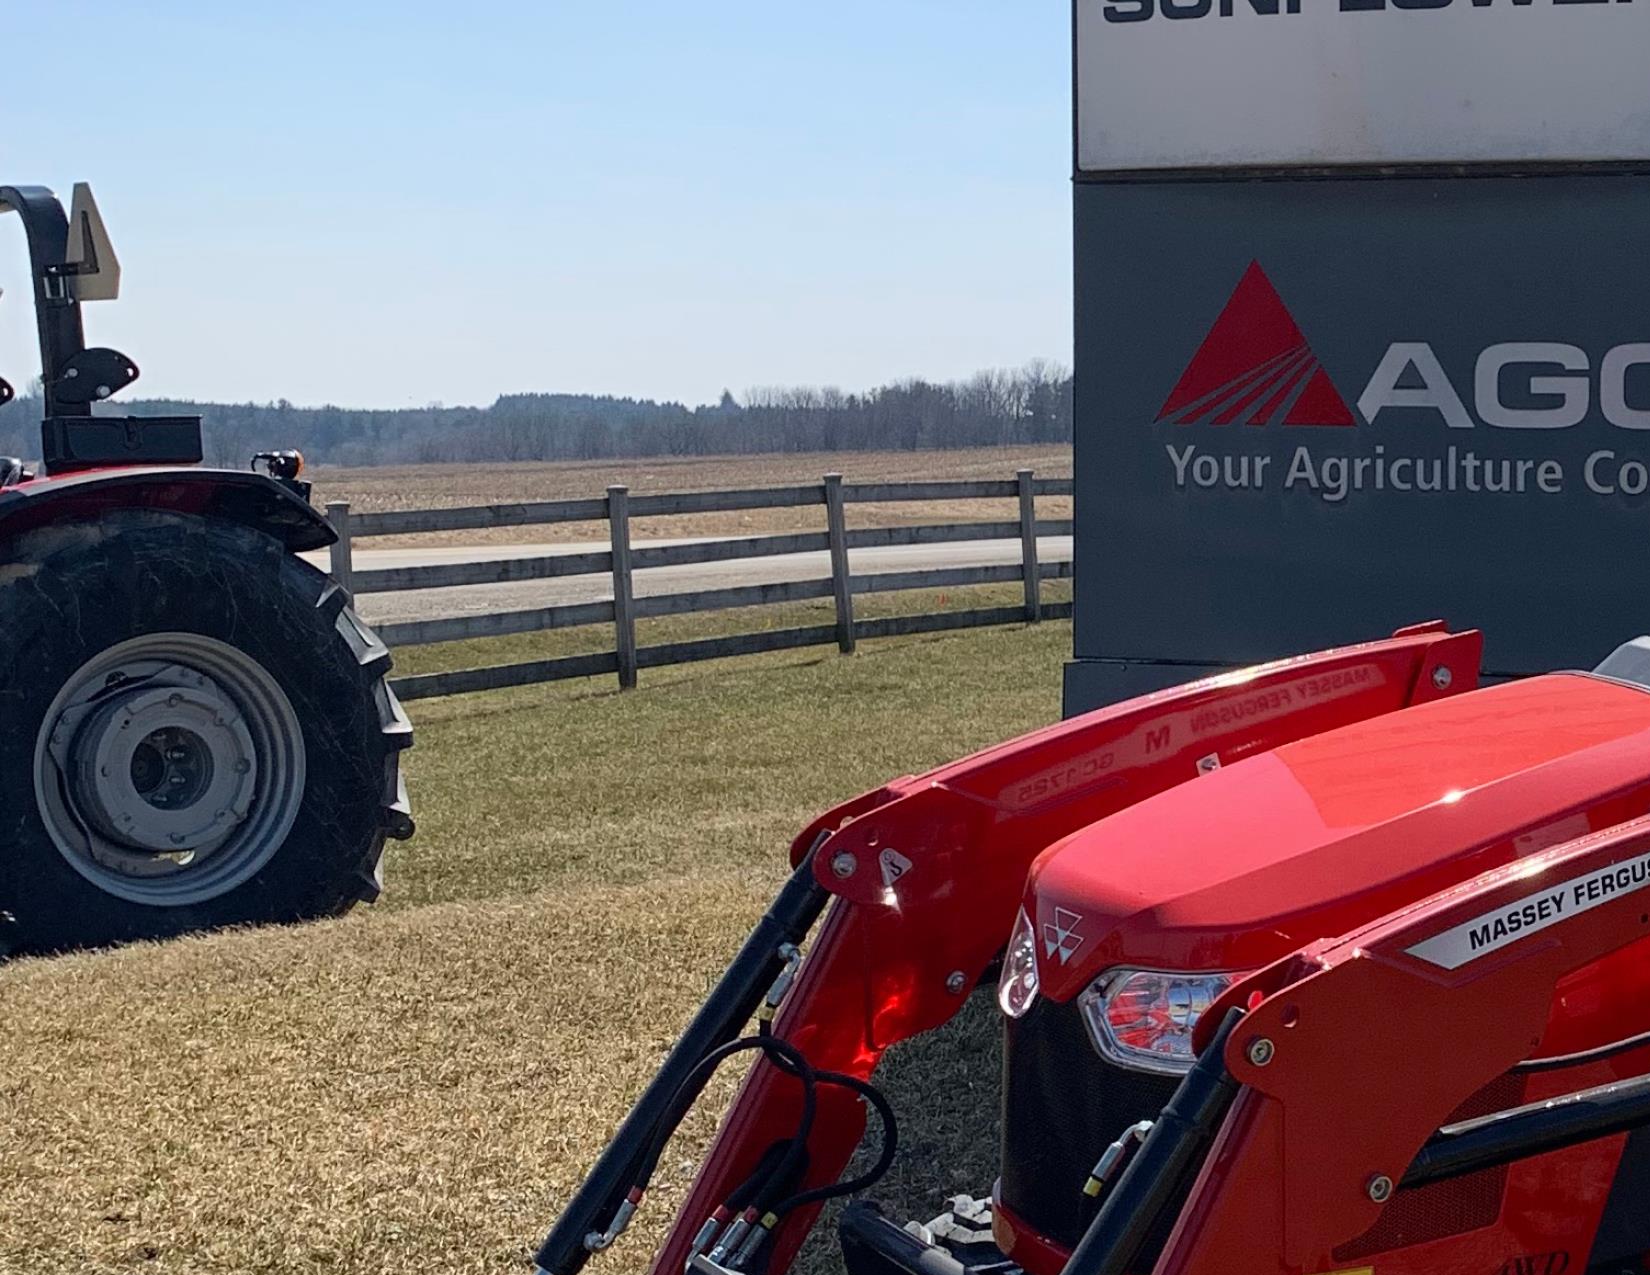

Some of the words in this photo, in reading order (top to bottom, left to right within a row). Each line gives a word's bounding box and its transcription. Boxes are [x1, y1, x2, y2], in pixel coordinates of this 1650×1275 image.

[1165, 444, 1271, 489] Your
[1285, 445, 1564, 502] Agriculture
[1468, 891, 1566, 950] MASSEY
